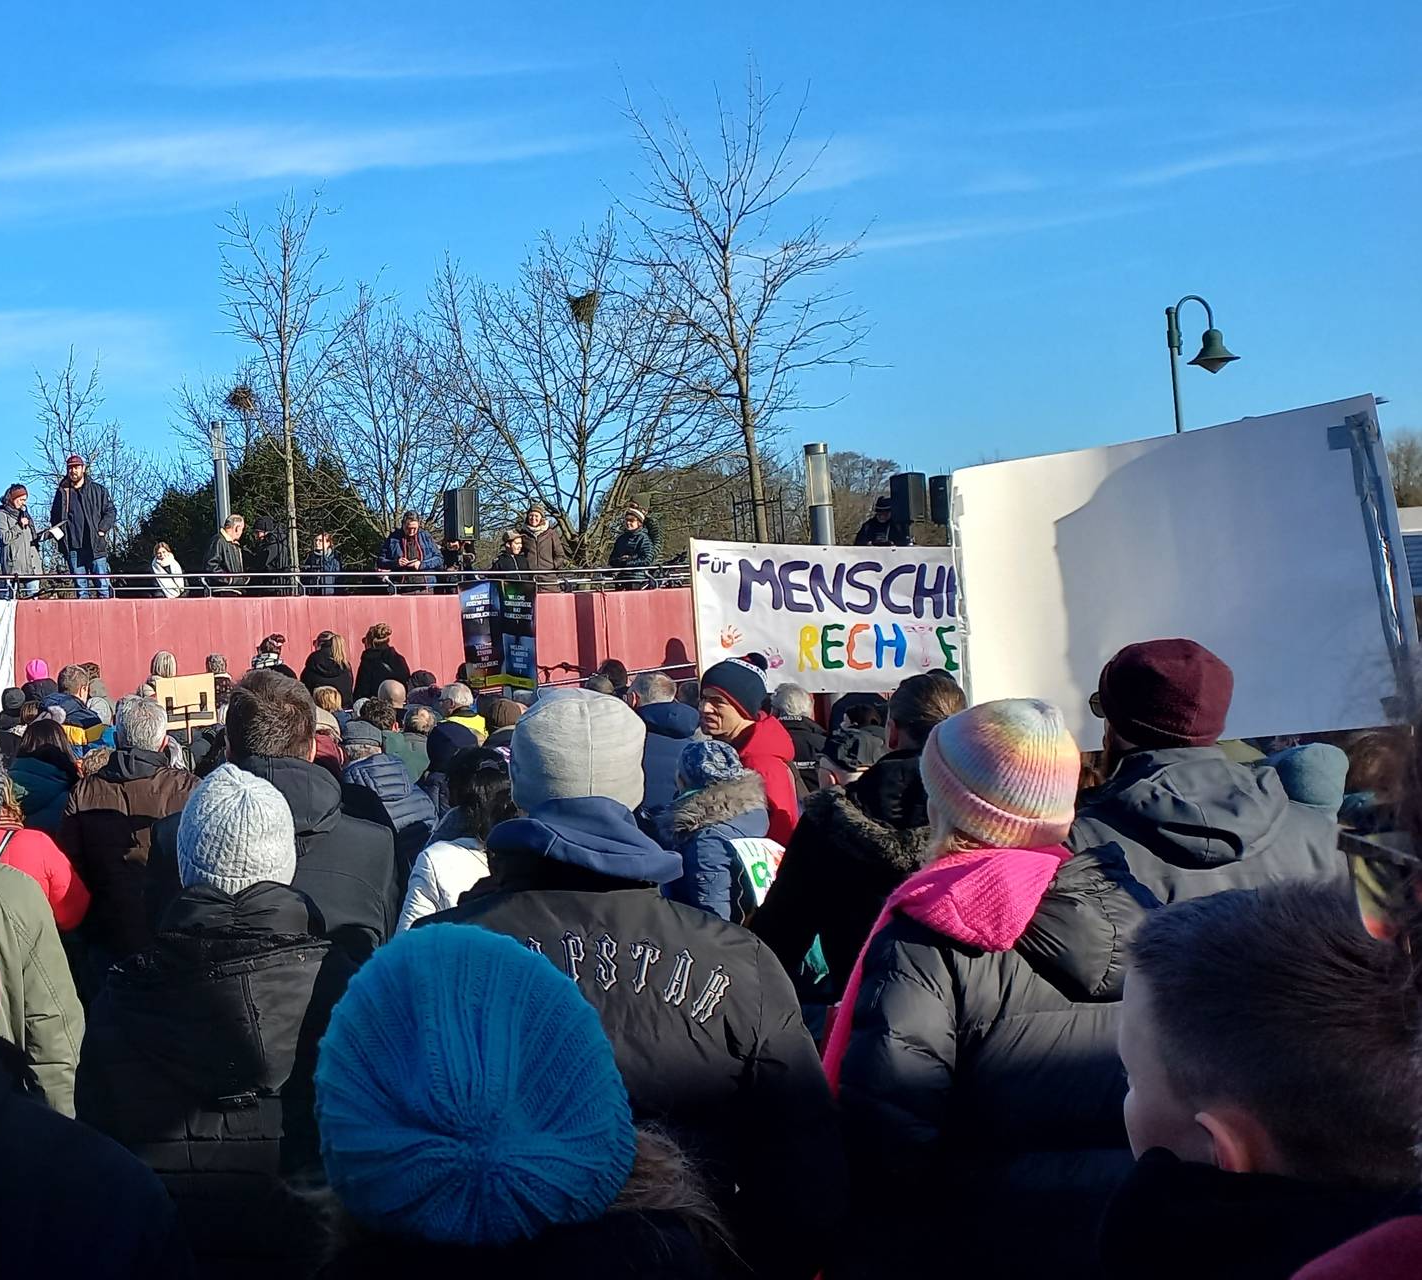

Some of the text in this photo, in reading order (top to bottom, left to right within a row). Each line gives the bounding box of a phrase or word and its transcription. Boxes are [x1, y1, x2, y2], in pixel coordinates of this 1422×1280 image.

[696, 553, 733, 574] Für
[798, 623, 960, 672] RECHTE
[527, 931, 731, 1025] PSTAR
